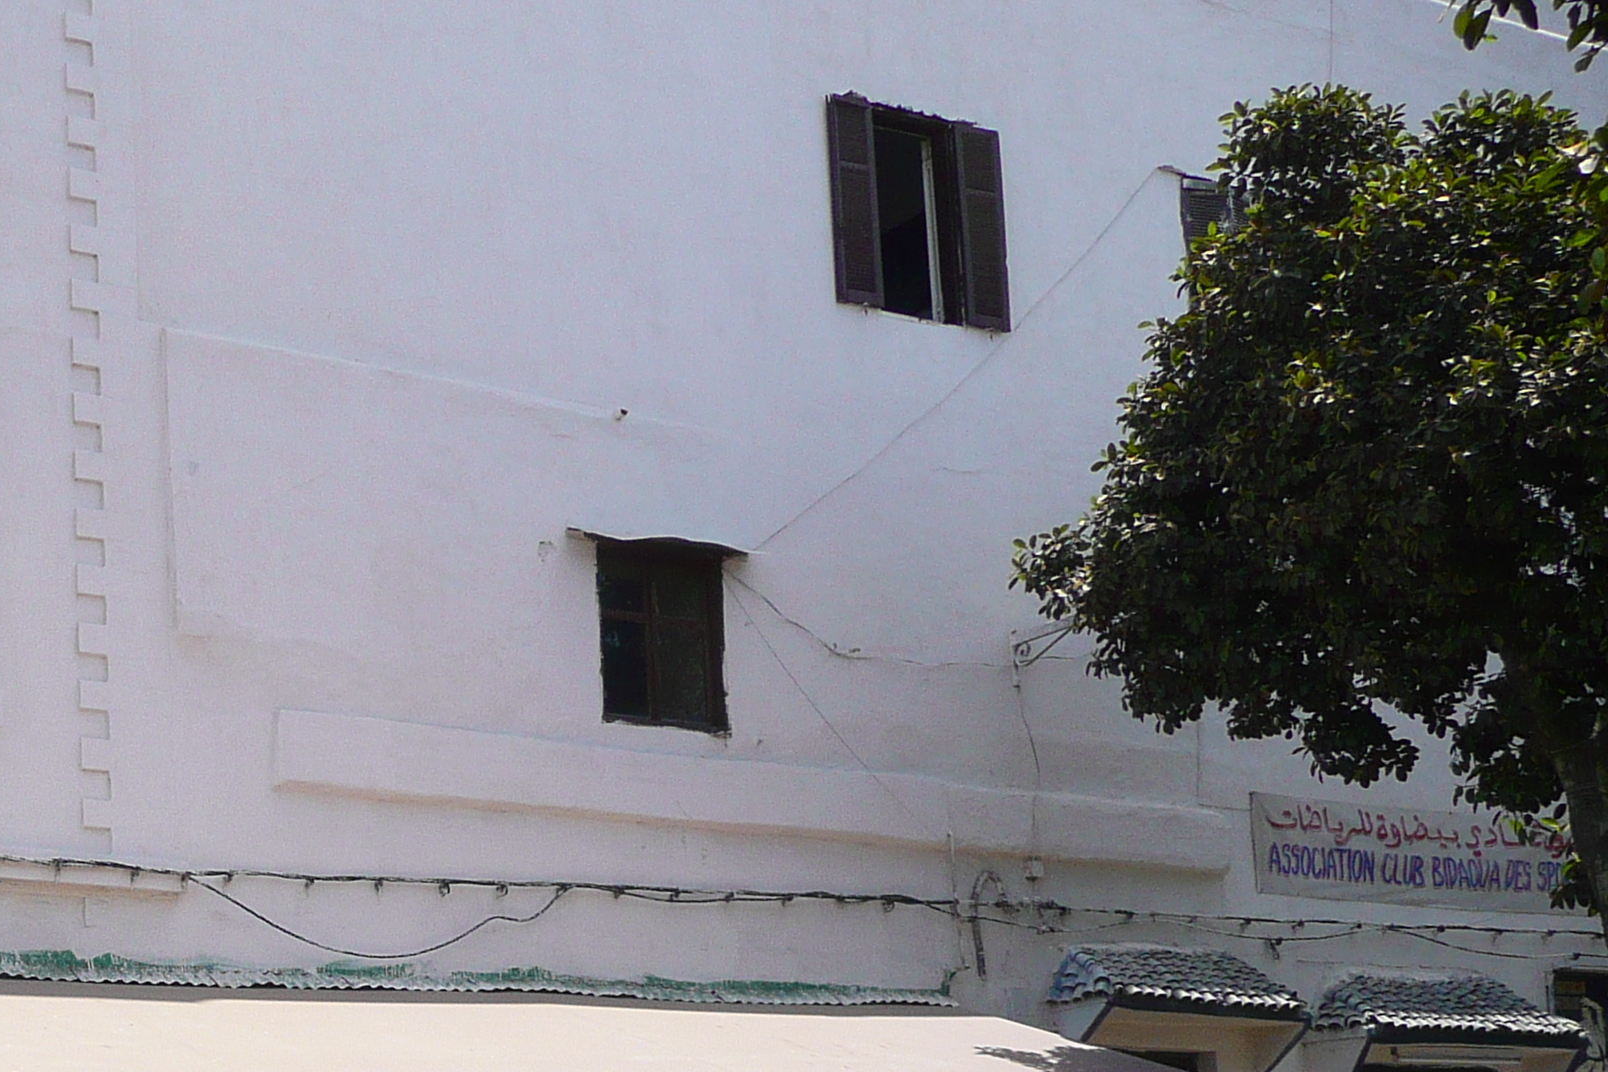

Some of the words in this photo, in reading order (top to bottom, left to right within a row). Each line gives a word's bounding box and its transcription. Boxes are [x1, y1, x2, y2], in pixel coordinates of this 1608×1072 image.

[1269, 842, 1375, 885] ASSOCIATION
[1381, 852, 1425, 887] CLUB
[1505, 858, 1532, 892] DES
